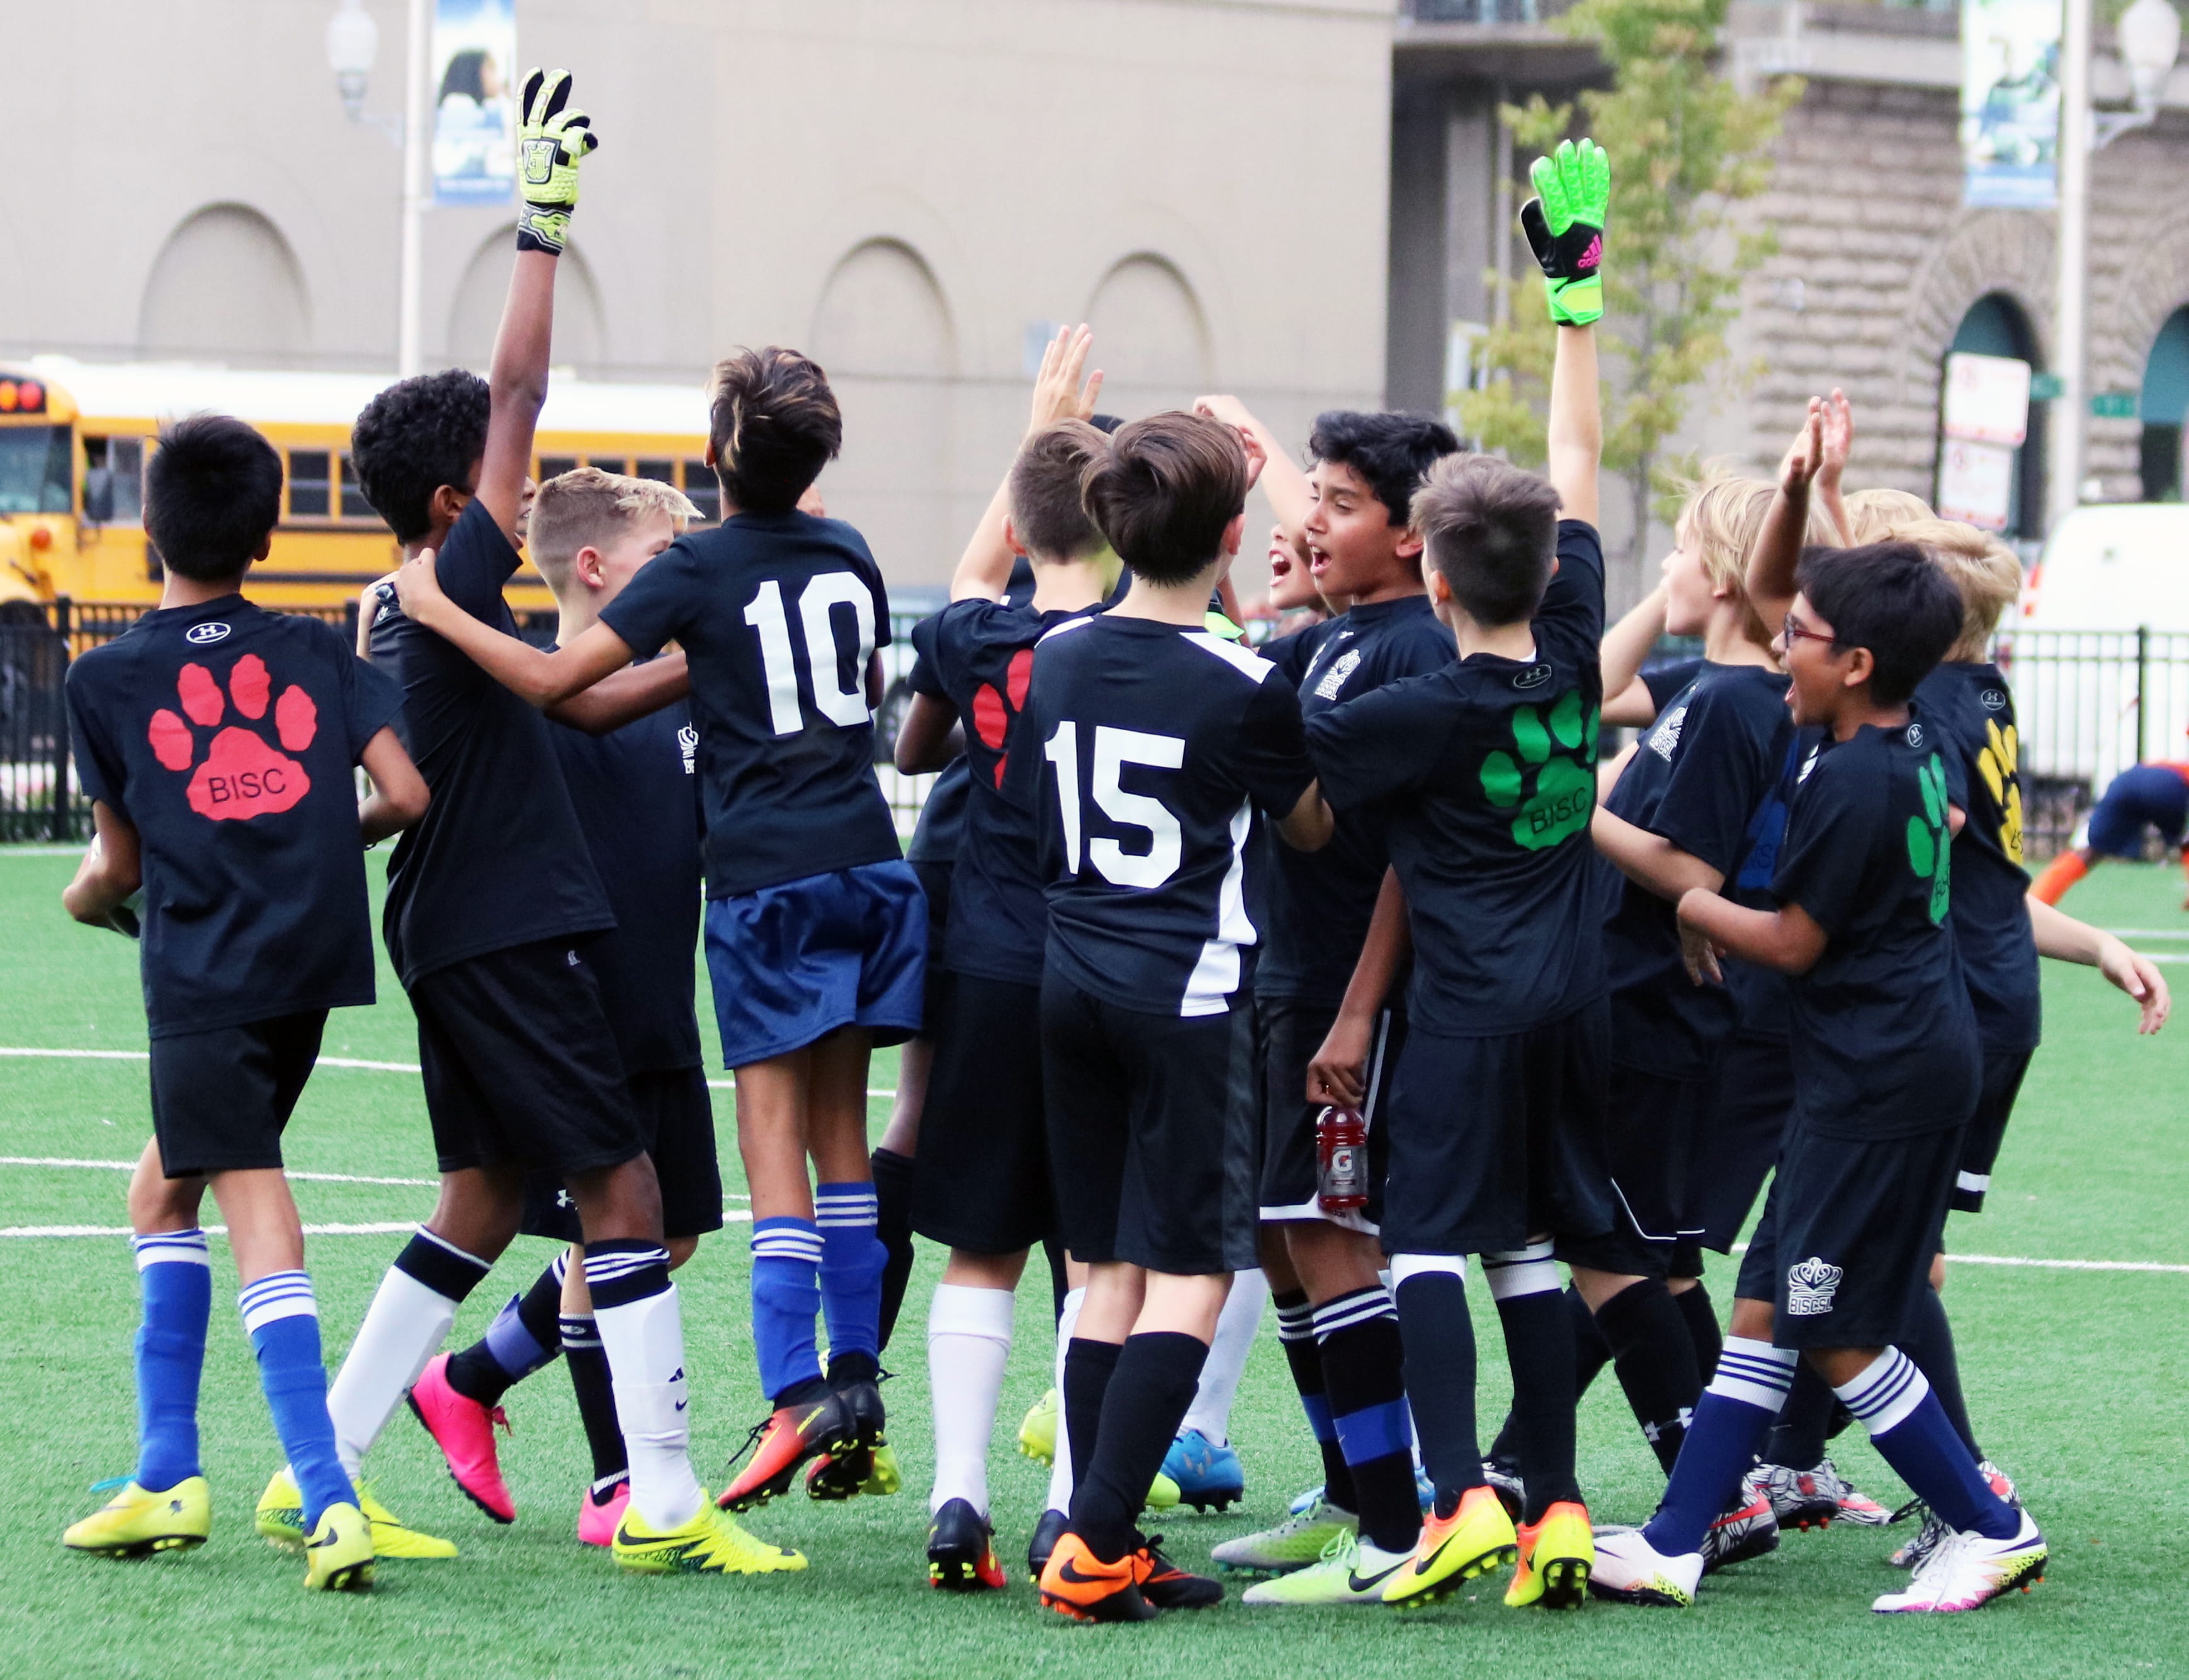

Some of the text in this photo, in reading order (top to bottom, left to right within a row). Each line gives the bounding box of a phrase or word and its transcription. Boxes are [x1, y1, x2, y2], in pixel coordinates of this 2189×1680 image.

[744, 571, 876, 736] 10
[208, 768, 286, 804] BISC
[1044, 721, 1185, 889] 15
[1530, 787, 1587, 835] BISC
[1333, 1149, 1352, 1171] G
[1789, 1297, 1833, 1315] BISCSL
